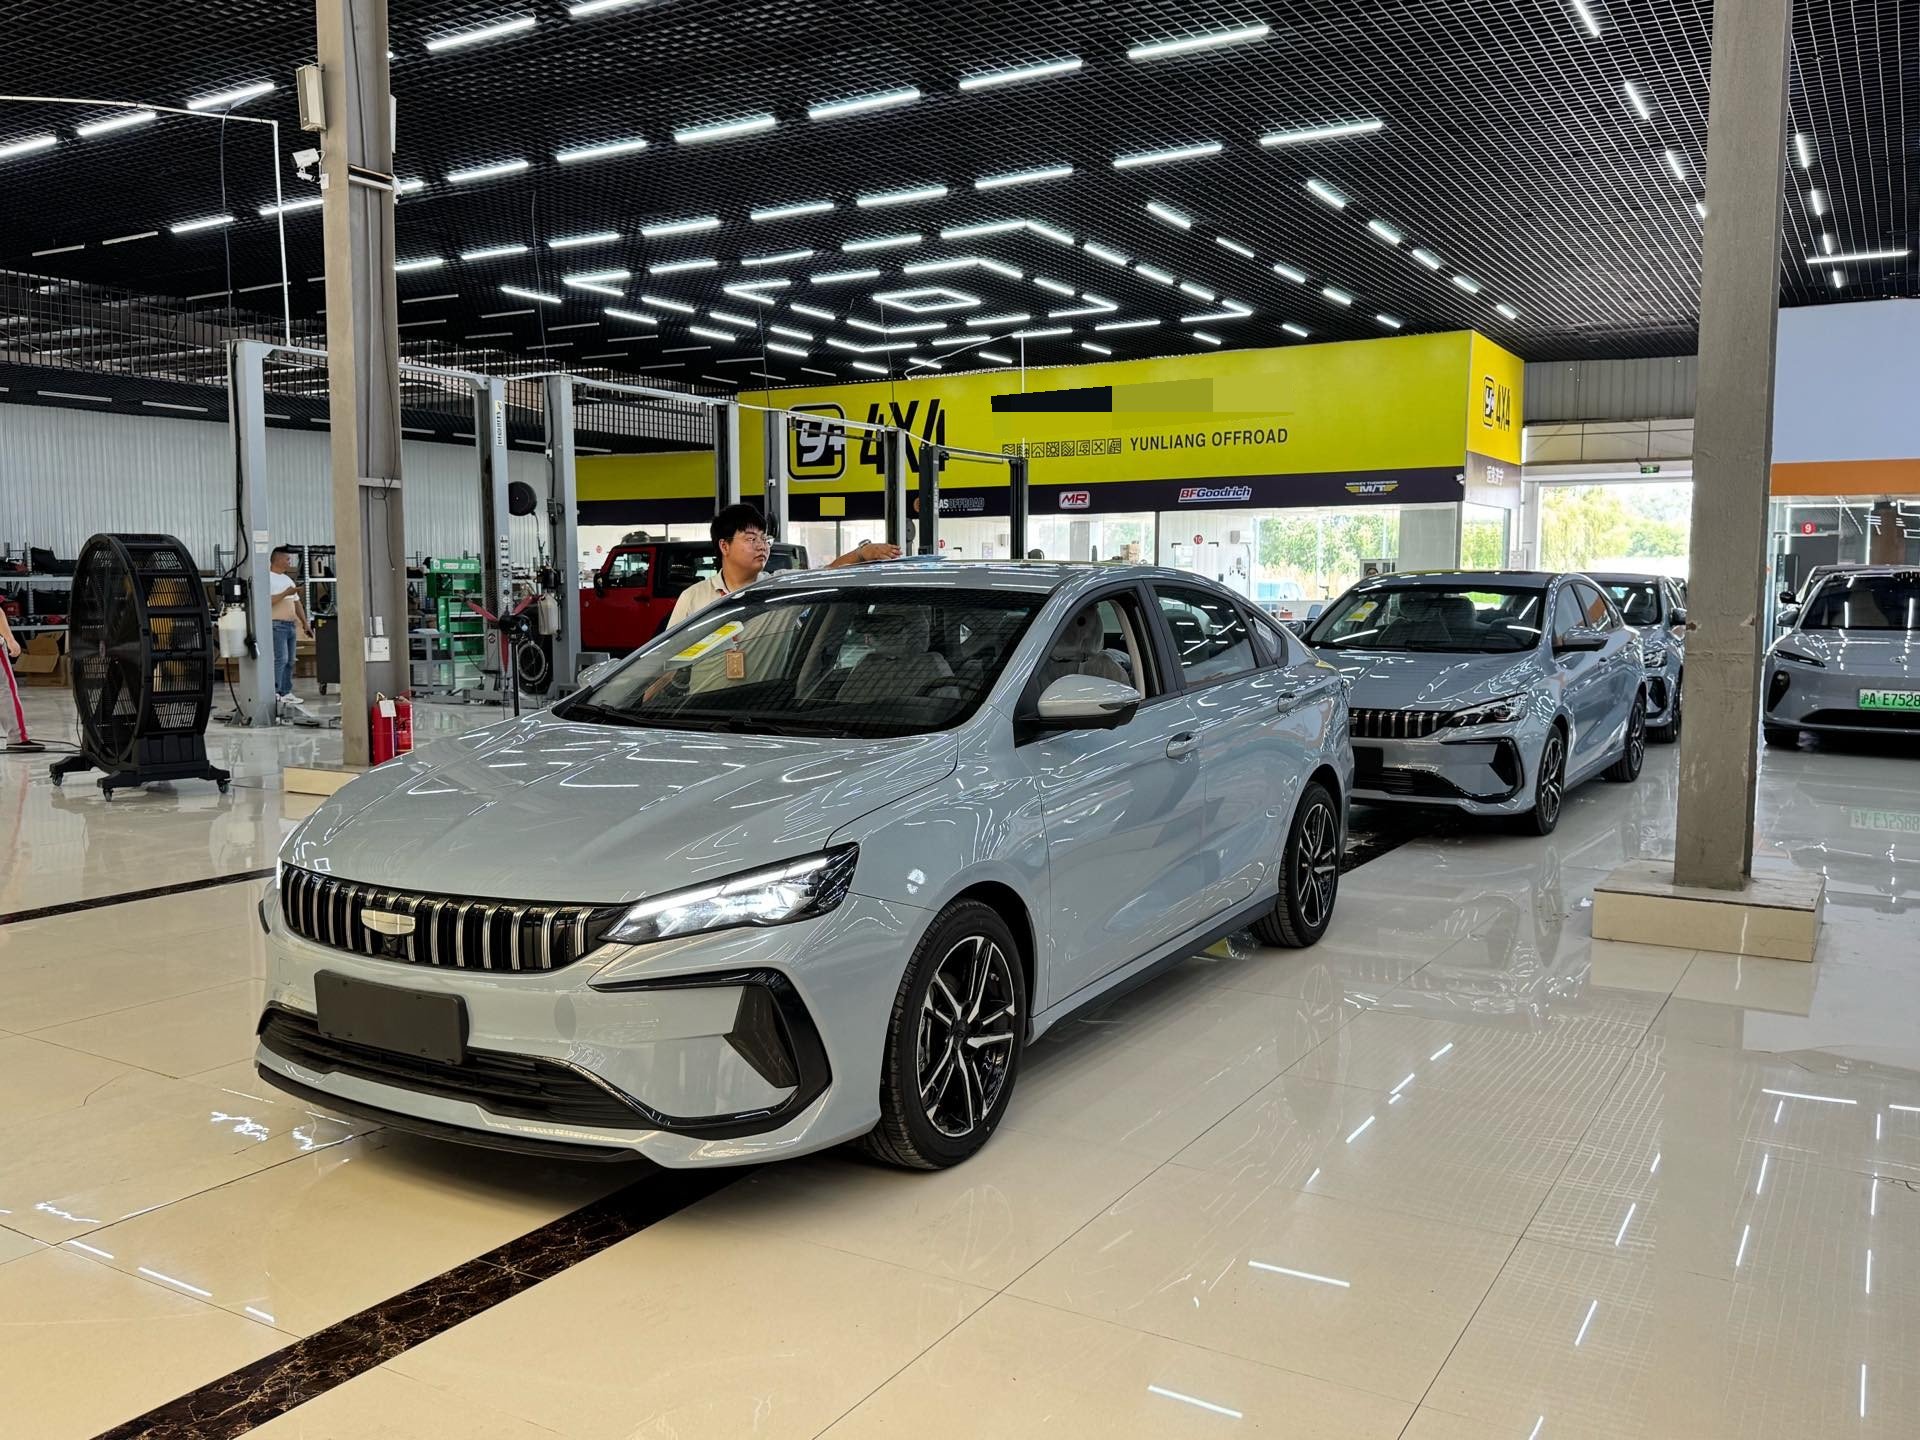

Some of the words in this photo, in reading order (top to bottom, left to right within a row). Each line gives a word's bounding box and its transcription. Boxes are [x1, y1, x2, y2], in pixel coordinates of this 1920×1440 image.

[860, 399, 945, 474] 4X4
[1130, 433, 1206, 451] YUNLIANG
[1211, 428, 1288, 446] OFFROAD
[1180, 487, 1250, 499] BFGoodrich
[1805, 523, 1812, 533] 9
